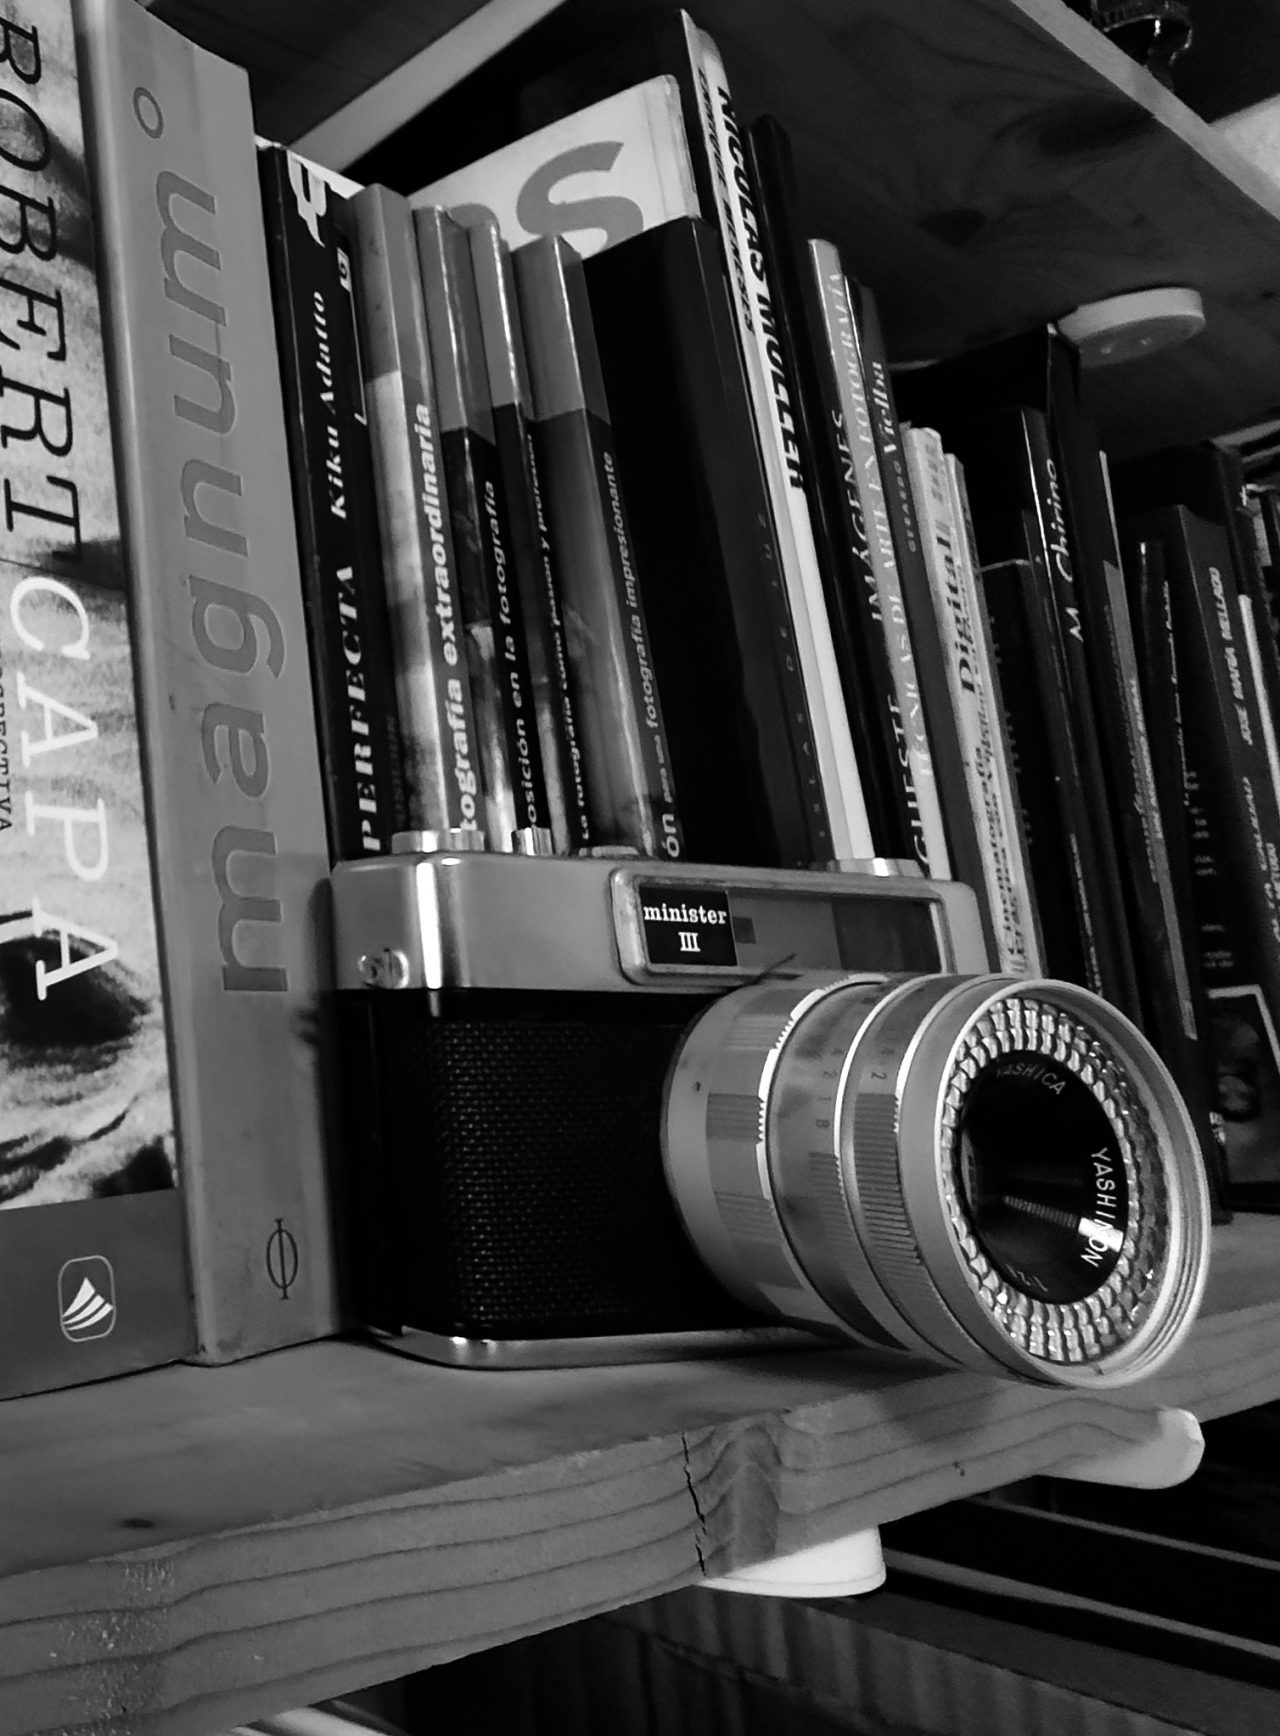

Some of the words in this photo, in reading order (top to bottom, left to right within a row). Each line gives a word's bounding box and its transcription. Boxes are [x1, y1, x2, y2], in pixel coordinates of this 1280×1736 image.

[313, 291, 337, 416] Adatto
[326, 425, 347, 519] Kiku
[414, 403, 458, 667] extraordinaria
[603, 451, 638, 608] impresionante
[155, 170, 289, 992] magnum
[485, 480, 512, 625] fotografía
[936, 535, 975, 693] Digital
[336, 566, 381, 851] PERFECTA
[504, 636, 517, 661] la
[509, 671, 522, 708] en
[631, 614, 659, 728] fotografía
[9, 575, 118, 1001] CAPA
[643, 902, 728, 925] minister
[678, 931, 701, 952] III
